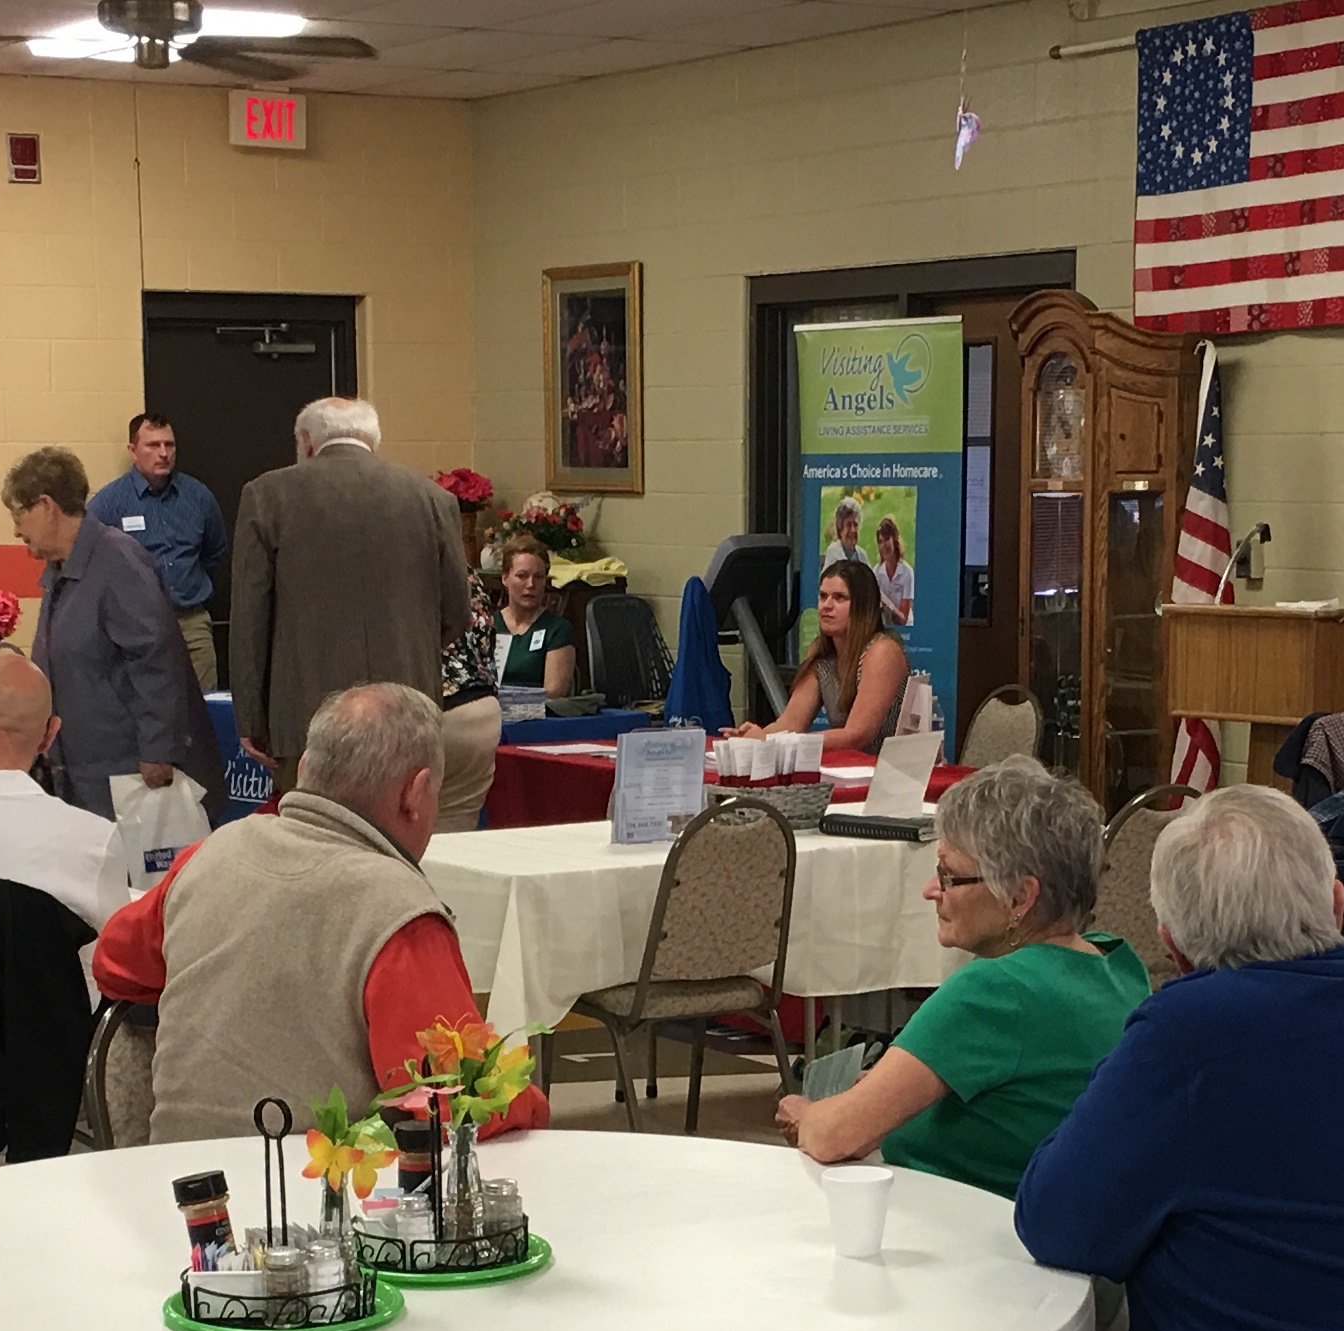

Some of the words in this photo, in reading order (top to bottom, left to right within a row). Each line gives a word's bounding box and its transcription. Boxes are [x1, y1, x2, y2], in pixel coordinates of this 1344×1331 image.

[246, 97, 296, 142] EXIT
[821, 346, 885, 391] Visiting
[823, 386, 894, 416] Angels
[819, 426, 845, 436] LIVING
[846, 425, 891, 435] ASSISTANCE
[893, 423, 928, 434] SERVICES
[803, 464, 847, 479] America's
[850, 464, 881, 478] Choice
[883, 465, 891, 478] in
[893, 464, 938, 478] Homecare
